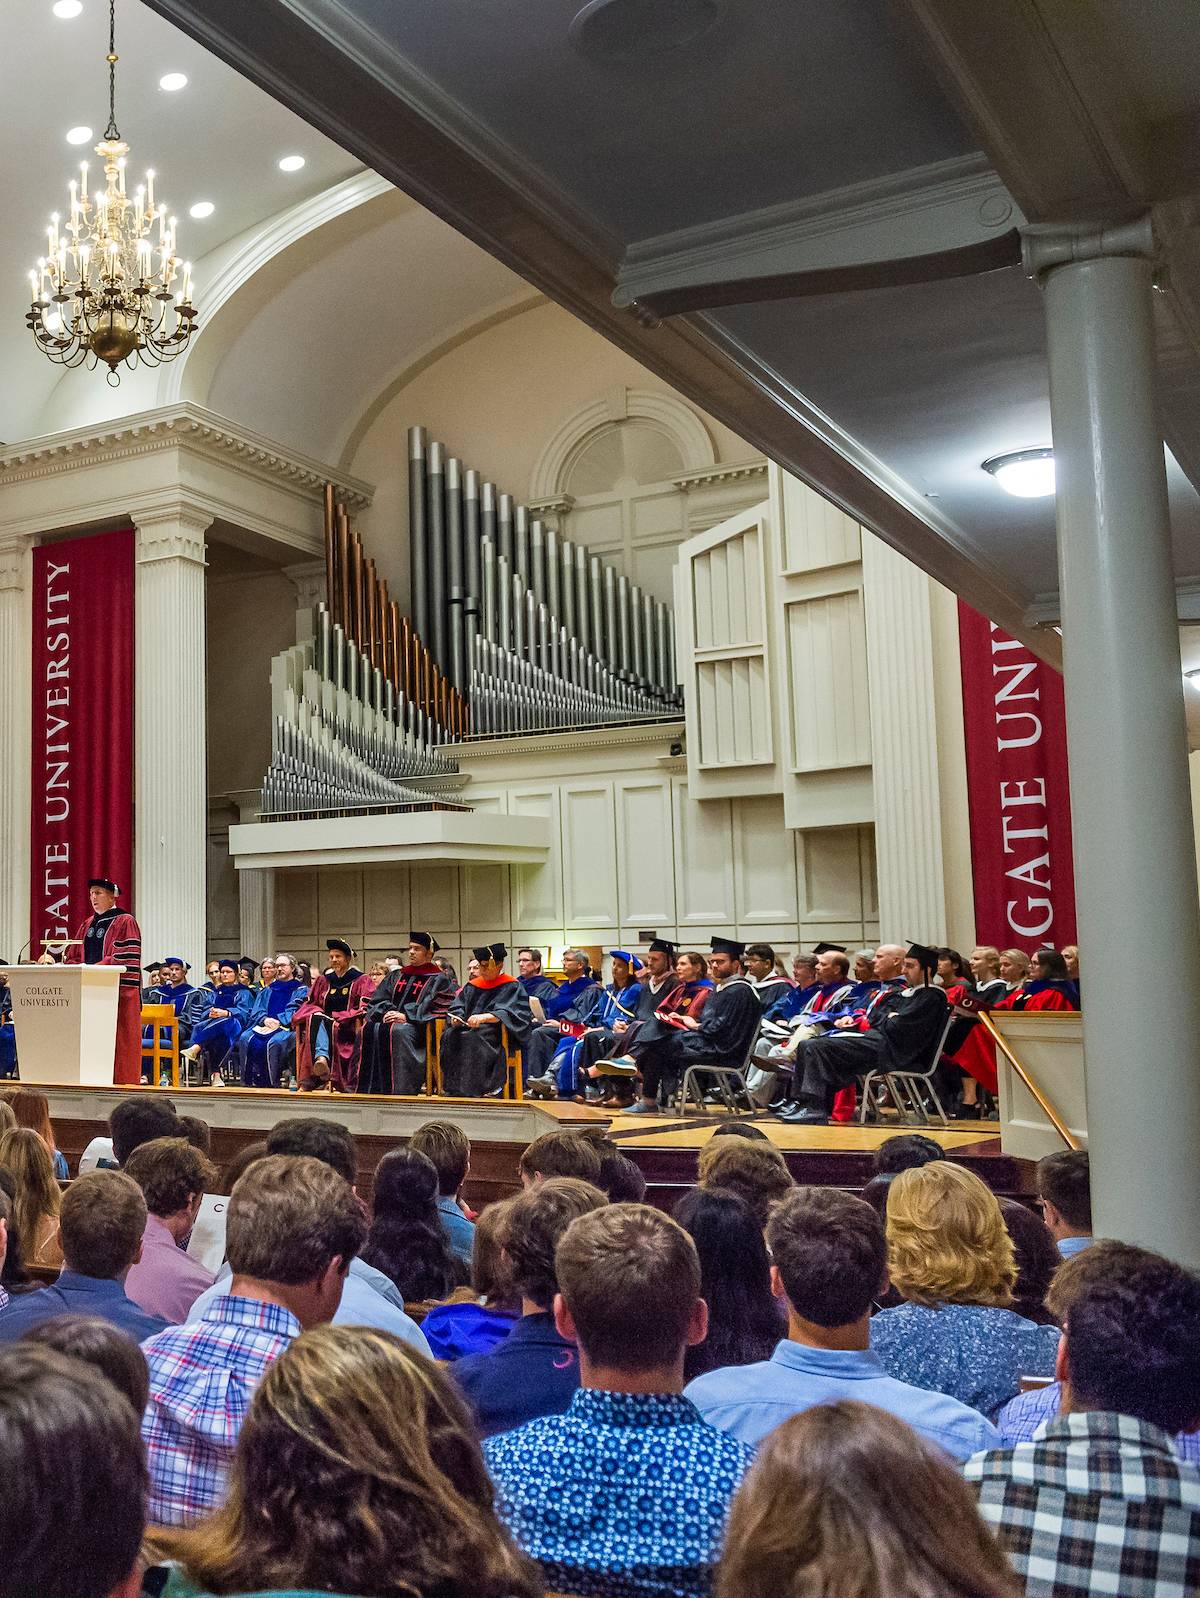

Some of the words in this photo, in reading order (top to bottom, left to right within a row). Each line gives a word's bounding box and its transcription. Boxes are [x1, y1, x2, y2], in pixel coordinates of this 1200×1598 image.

[46, 560, 71, 825] UNIVERSITY
[44, 842, 70, 954] GATE
[999, 777, 1054, 950] GATE
[20, 998, 70, 1007] UNIVERSITY
[25, 986, 63, 995] COLGATE
